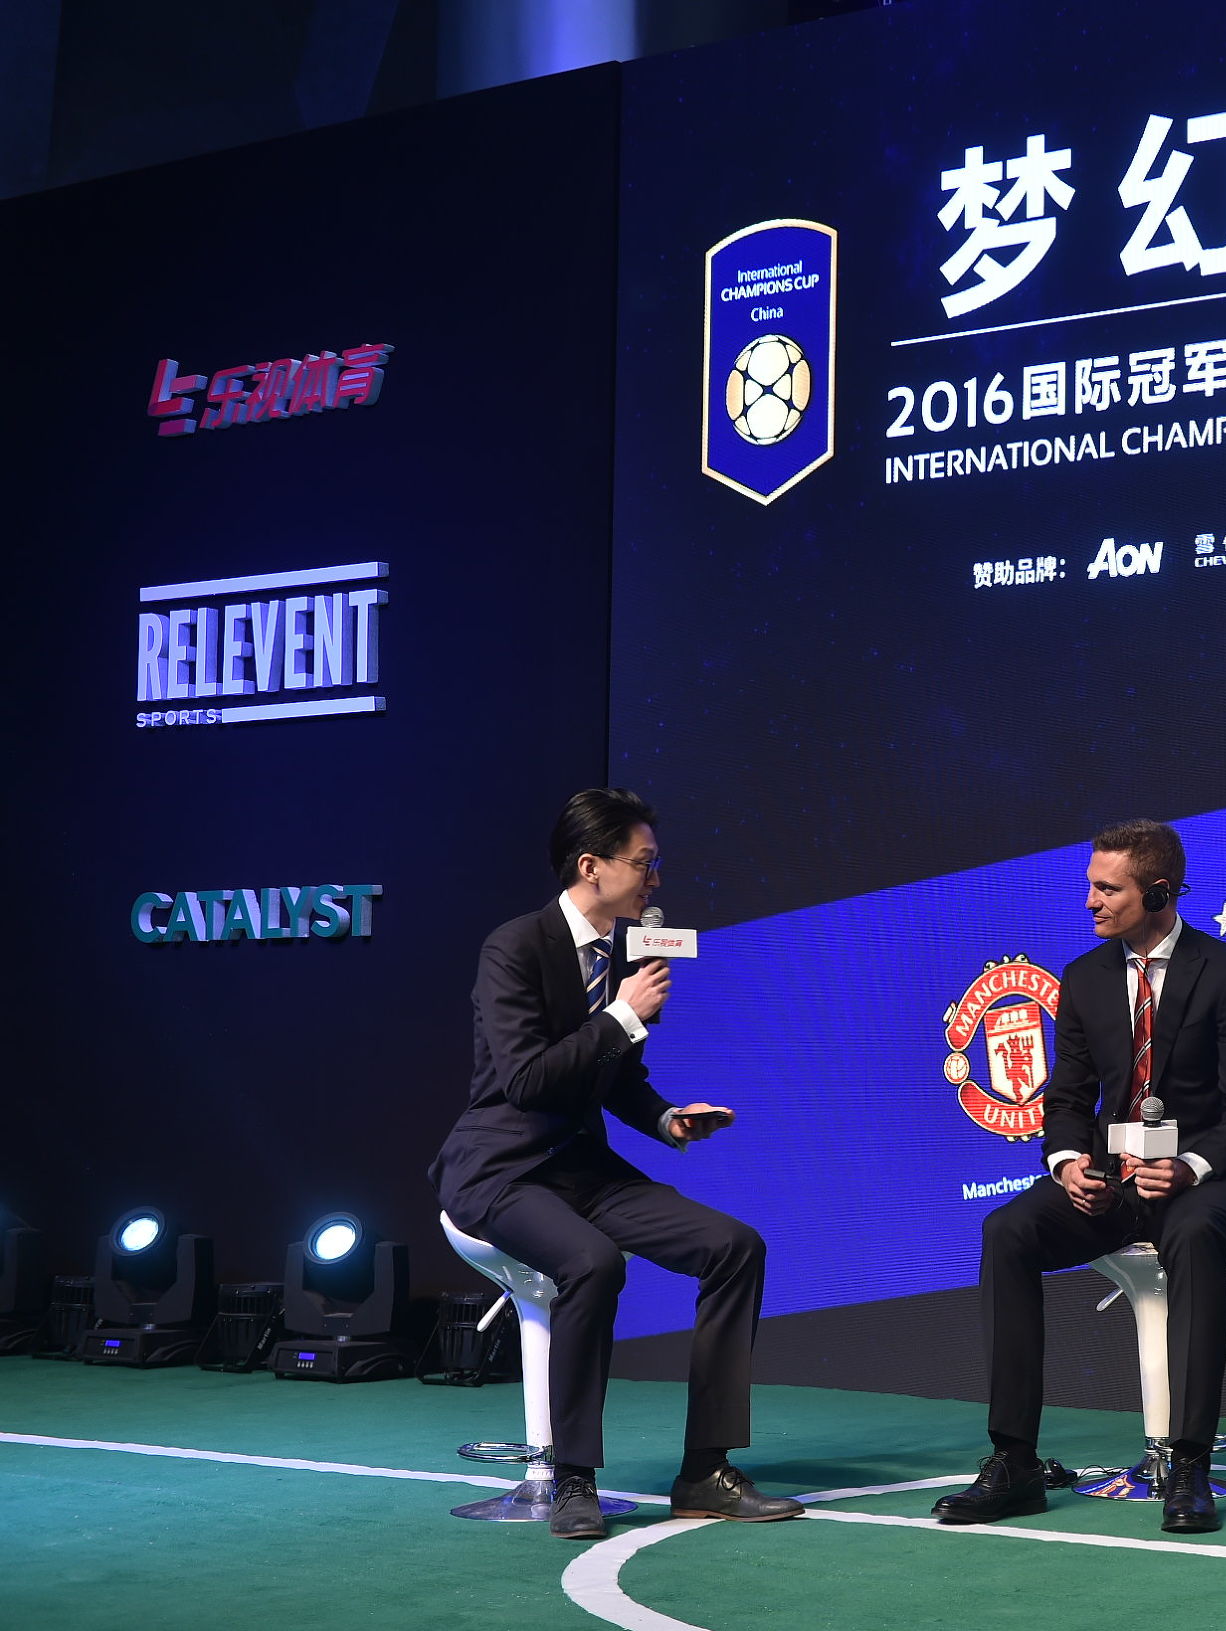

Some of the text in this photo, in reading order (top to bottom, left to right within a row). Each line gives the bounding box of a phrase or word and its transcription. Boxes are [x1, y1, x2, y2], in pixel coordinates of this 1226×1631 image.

[737, 259, 803, 284] International
[720, 273, 820, 302] CHAMPIONS CUP
[750, 305, 784, 322] China
[884, 430, 1115, 484] INTERNATIONAL
[137, 589, 388, 701] RELEVENT
[136, 708, 222, 728] SPORTS
[131, 884, 383, 943] CATALYST
[955, 969, 1059, 1037] MANCHESTE
[962, 1173, 1050, 1201] Manchest
